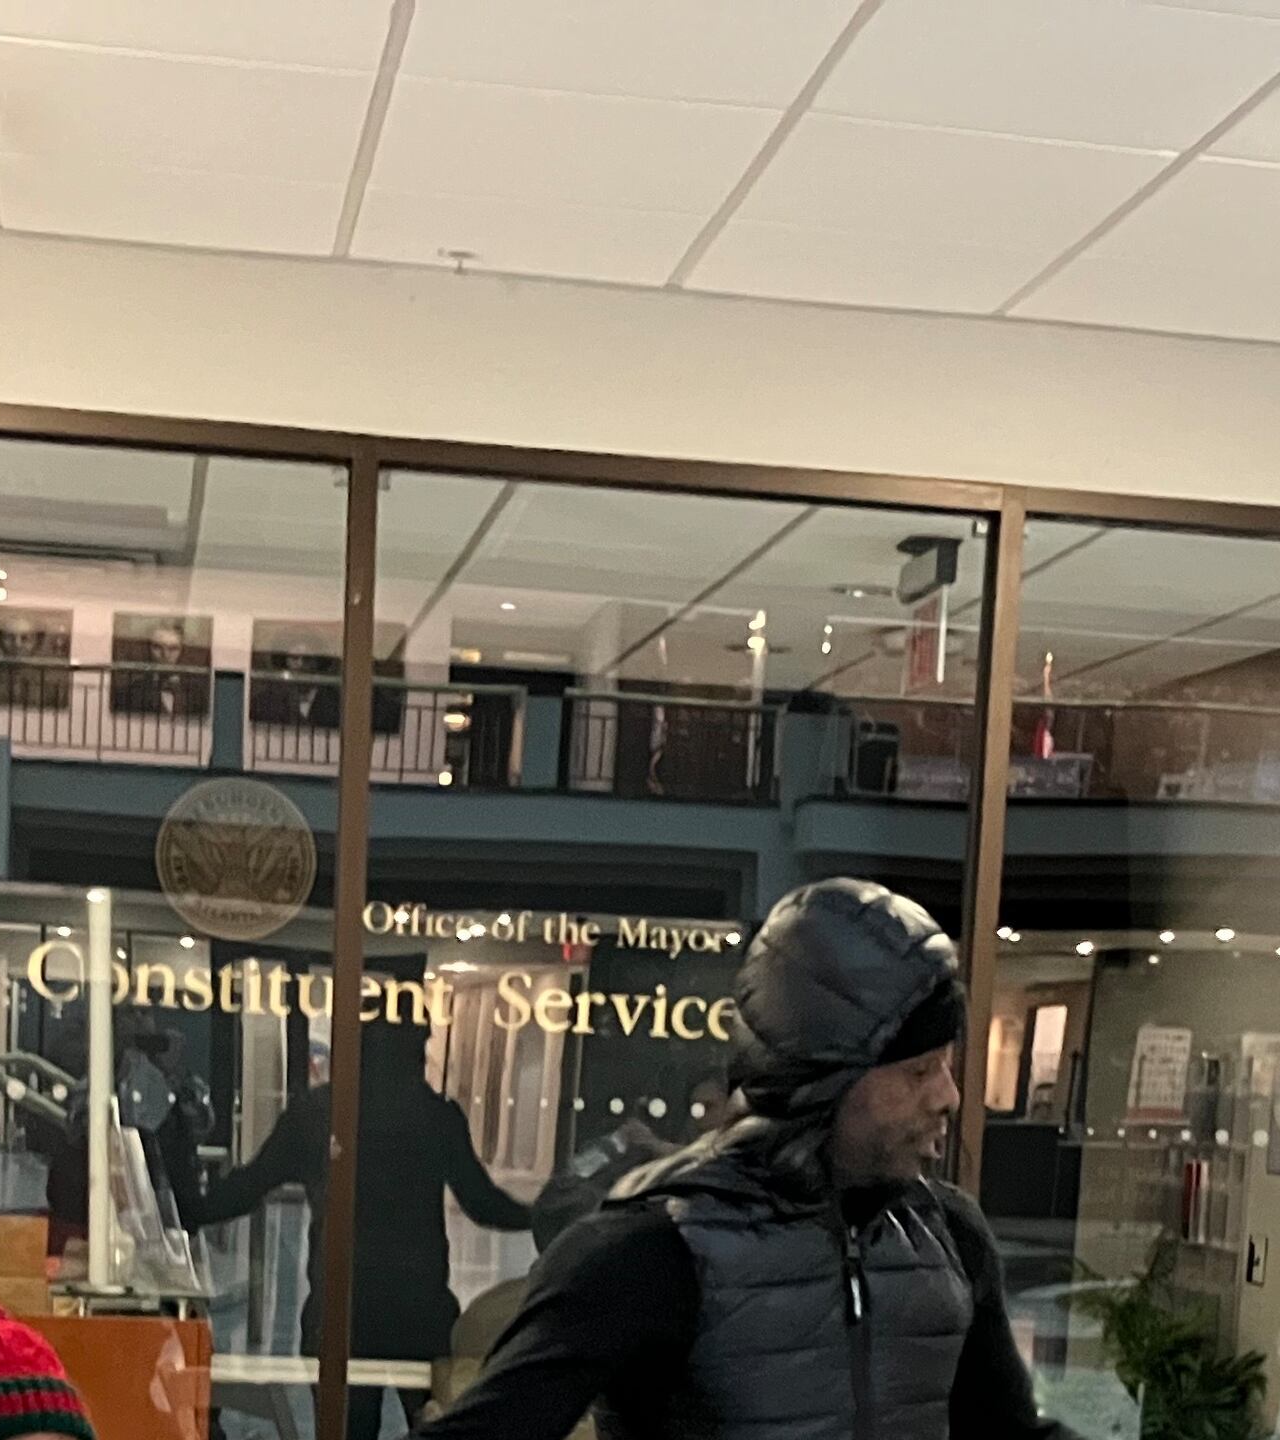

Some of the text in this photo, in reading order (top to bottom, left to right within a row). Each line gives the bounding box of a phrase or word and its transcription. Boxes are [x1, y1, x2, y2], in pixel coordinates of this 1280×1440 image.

[363, 901, 727, 959] Office of the Mayor
[494, 971, 734, 1040] Service
